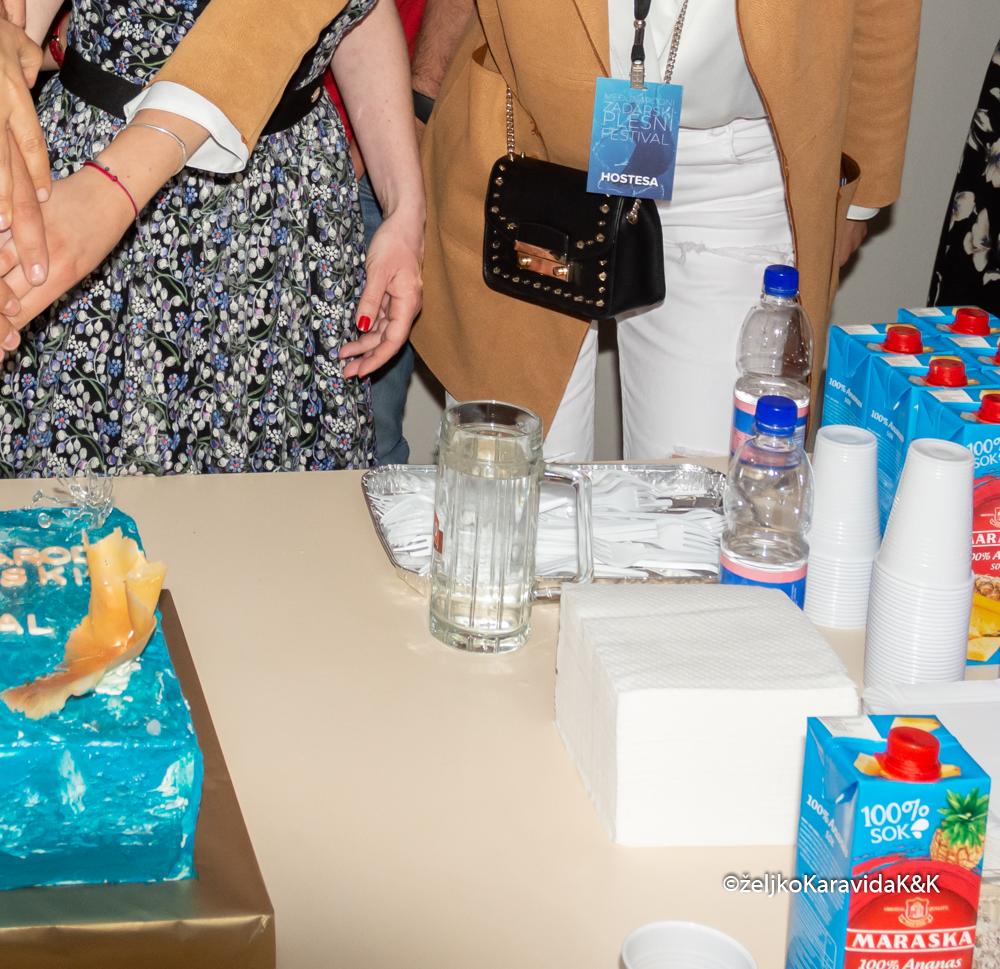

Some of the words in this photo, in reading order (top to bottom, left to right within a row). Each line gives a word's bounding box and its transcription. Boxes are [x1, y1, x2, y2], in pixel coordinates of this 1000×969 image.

[603, 101, 674, 117] ZADARSKI
[602, 112, 673, 131] PLESNI
[601, 128, 670, 146] FESTIVAL
[600, 172, 659, 187] HOSTESA
[806, 794, 829, 824] 100%
[860, 798, 930, 827] 100%
[870, 823, 911, 844] SOK
[852, 930, 973, 949] MARASKA
[902, 957, 962, 969] Ananas
